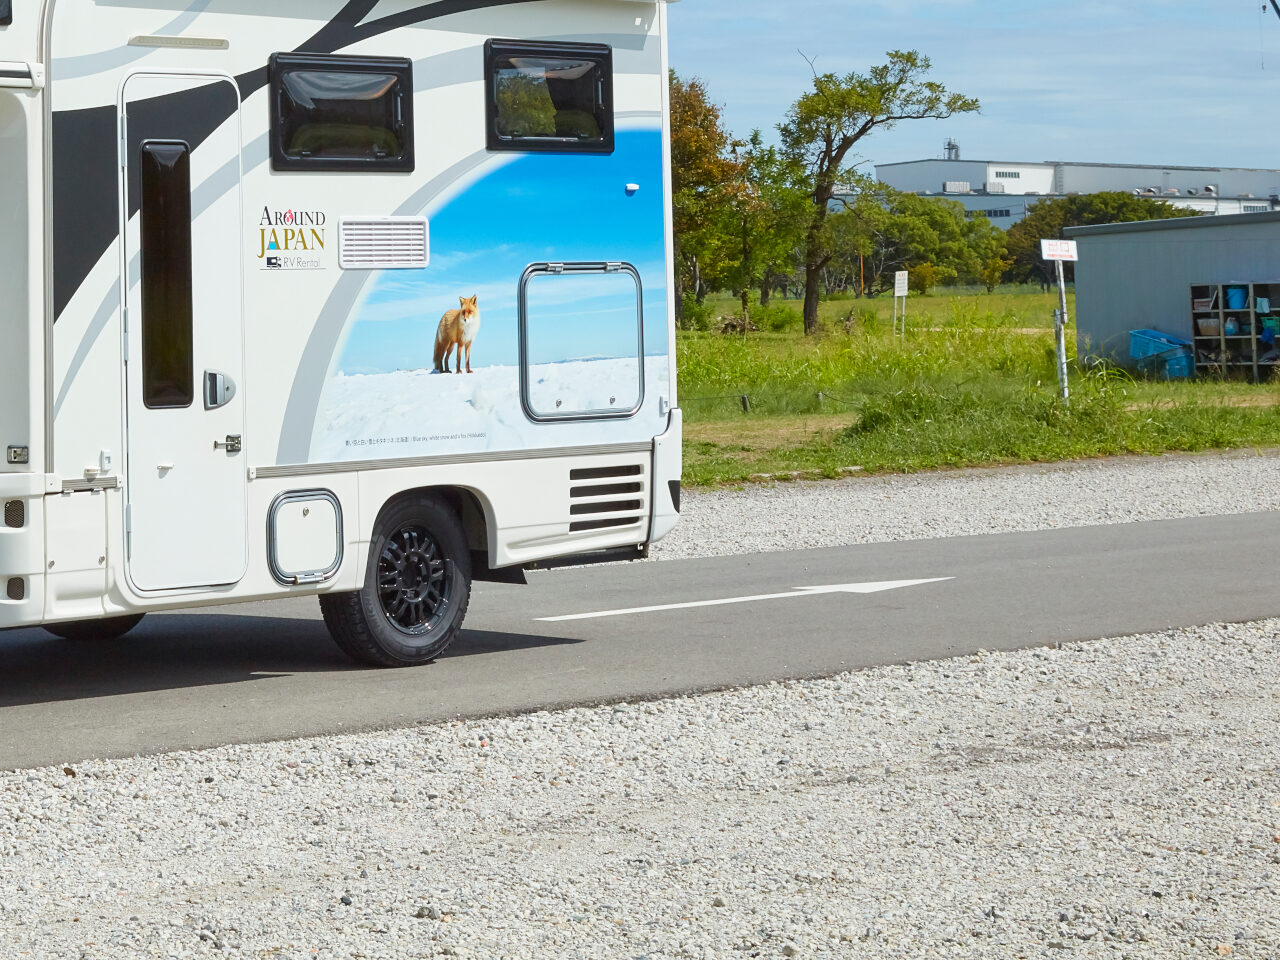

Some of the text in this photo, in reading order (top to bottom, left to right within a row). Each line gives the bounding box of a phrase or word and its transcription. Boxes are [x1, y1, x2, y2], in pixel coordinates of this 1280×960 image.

[259, 205, 326, 226] AROUND
[256, 227, 326, 259] JAPAN
[283, 256, 321, 268] RV Rental
